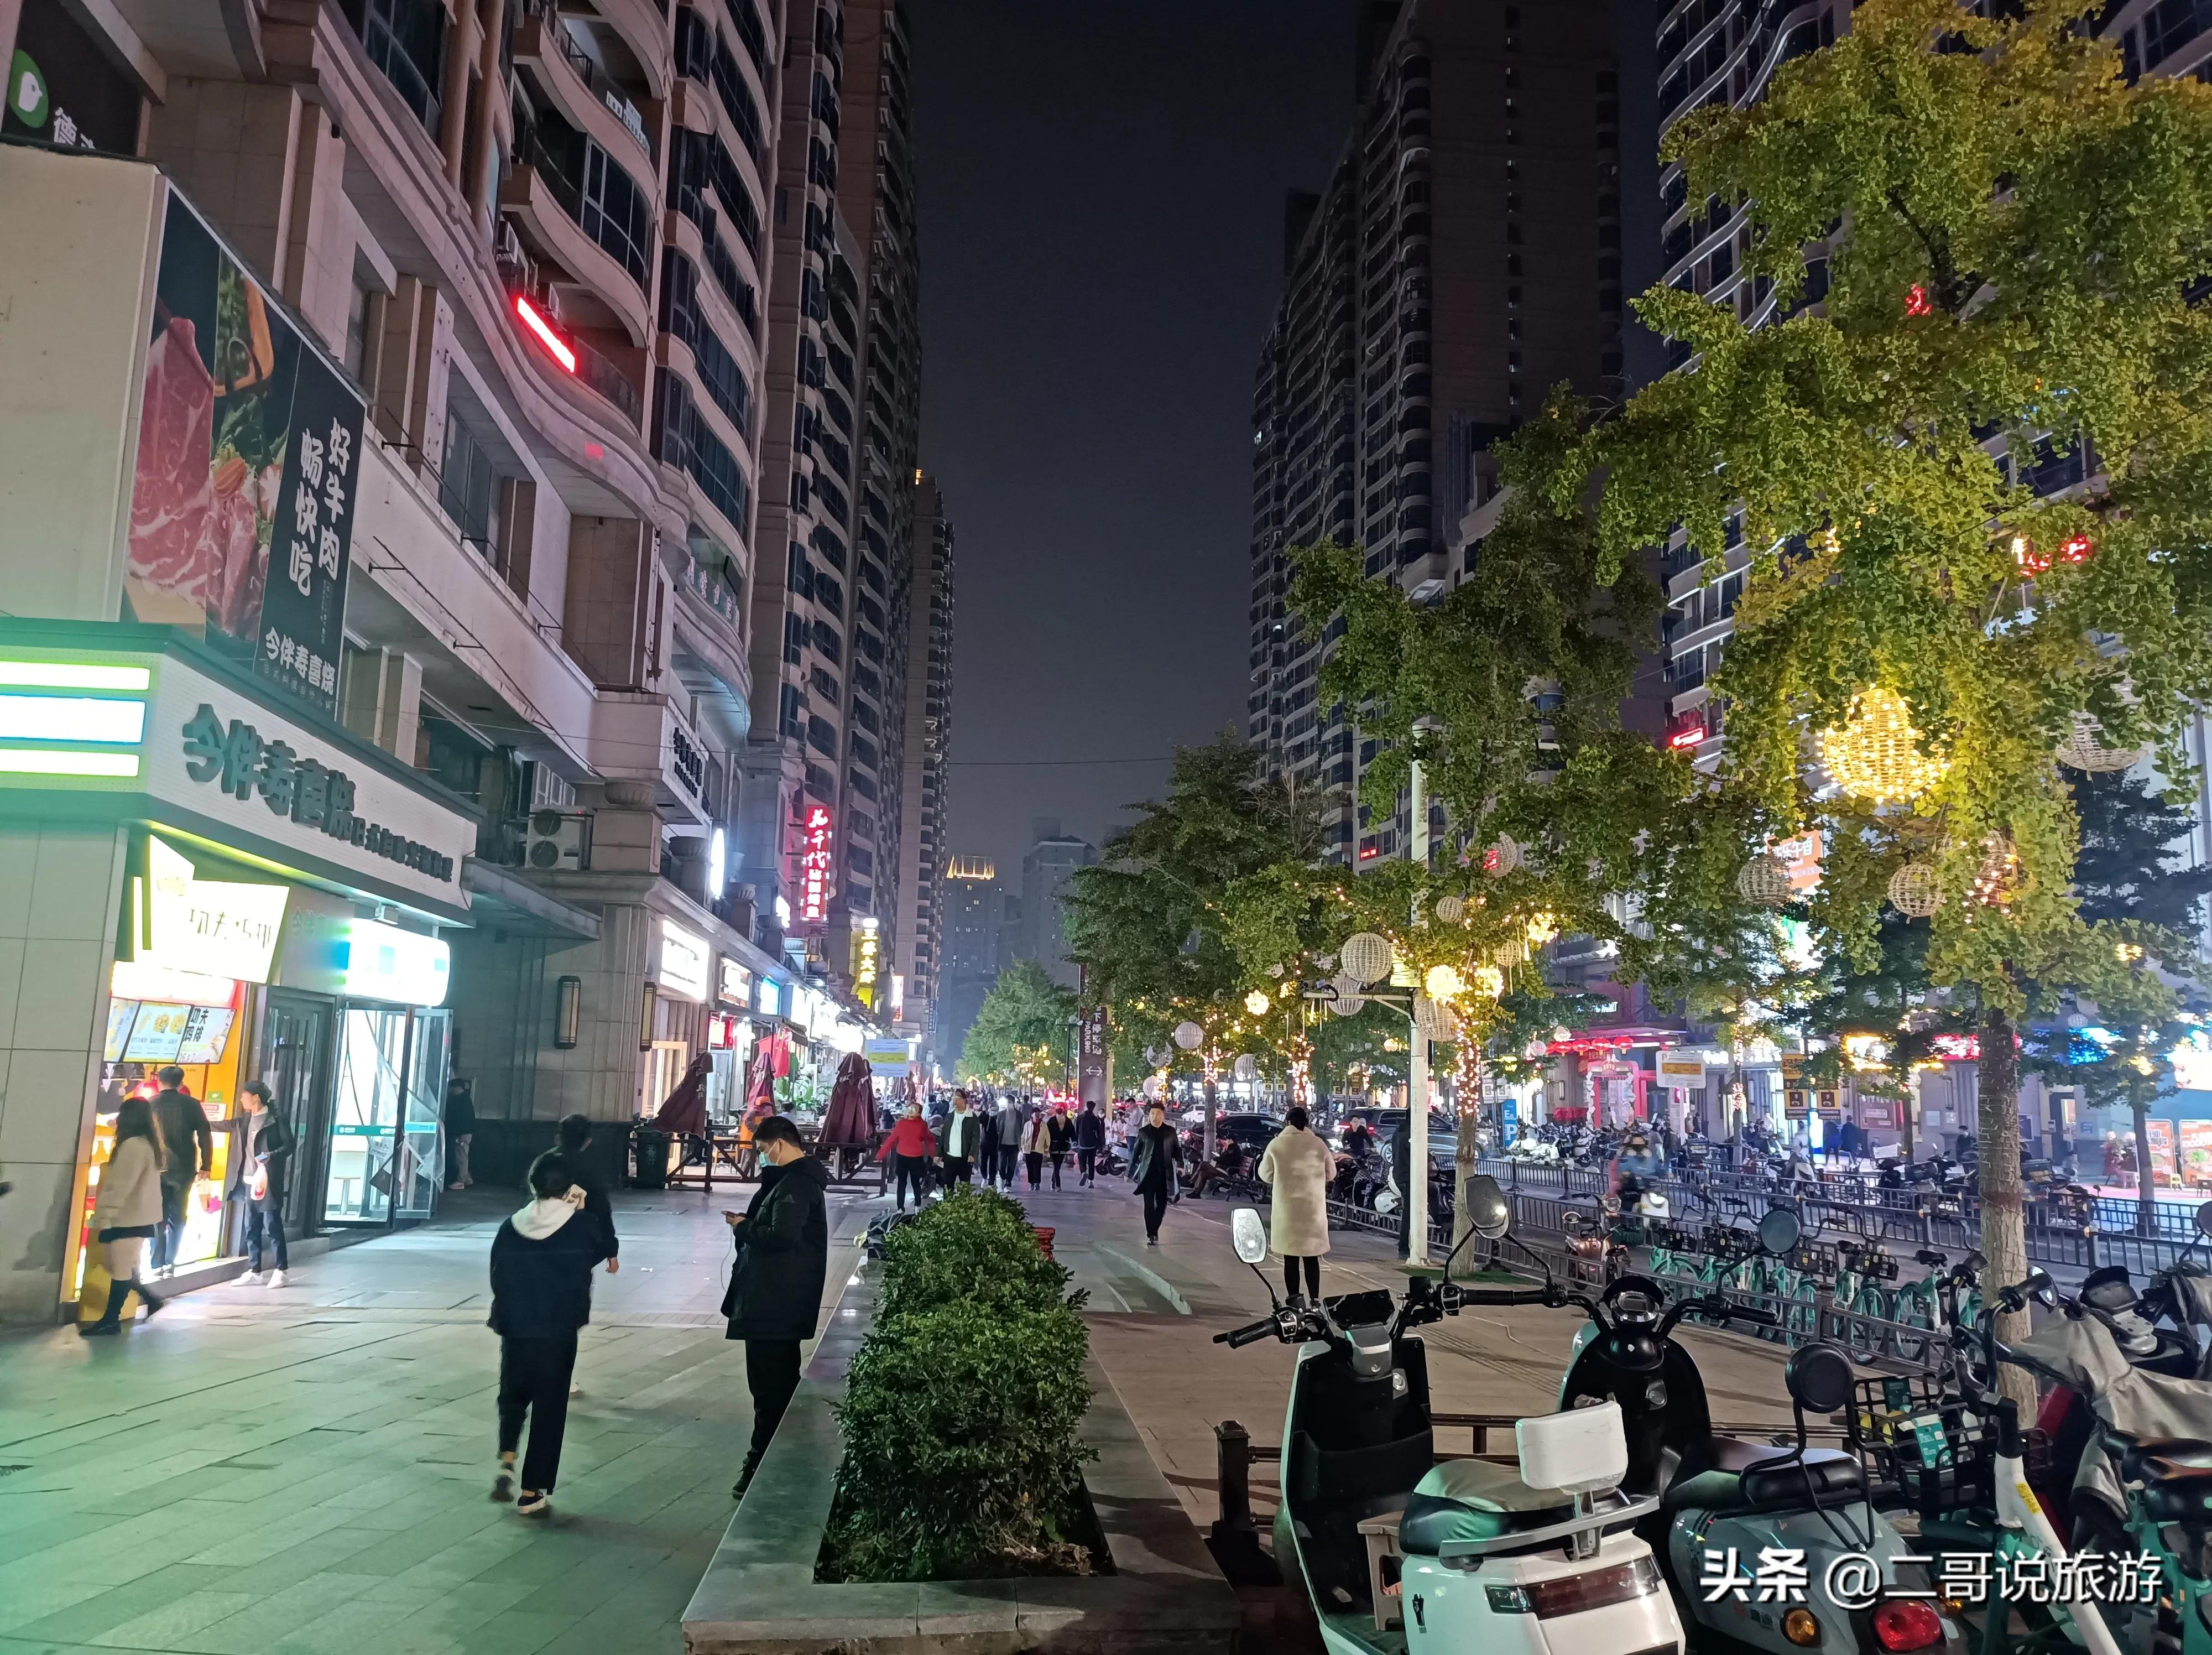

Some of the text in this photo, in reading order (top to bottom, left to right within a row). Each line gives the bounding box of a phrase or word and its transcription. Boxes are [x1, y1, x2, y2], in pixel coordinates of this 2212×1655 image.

[289, 428, 324, 597] 畅快吃
[319, 417, 351, 581] 好牛肉
[265, 626, 335, 695] 今伴寿喜烧
[182, 703, 356, 841] 今伴寿喜烧
